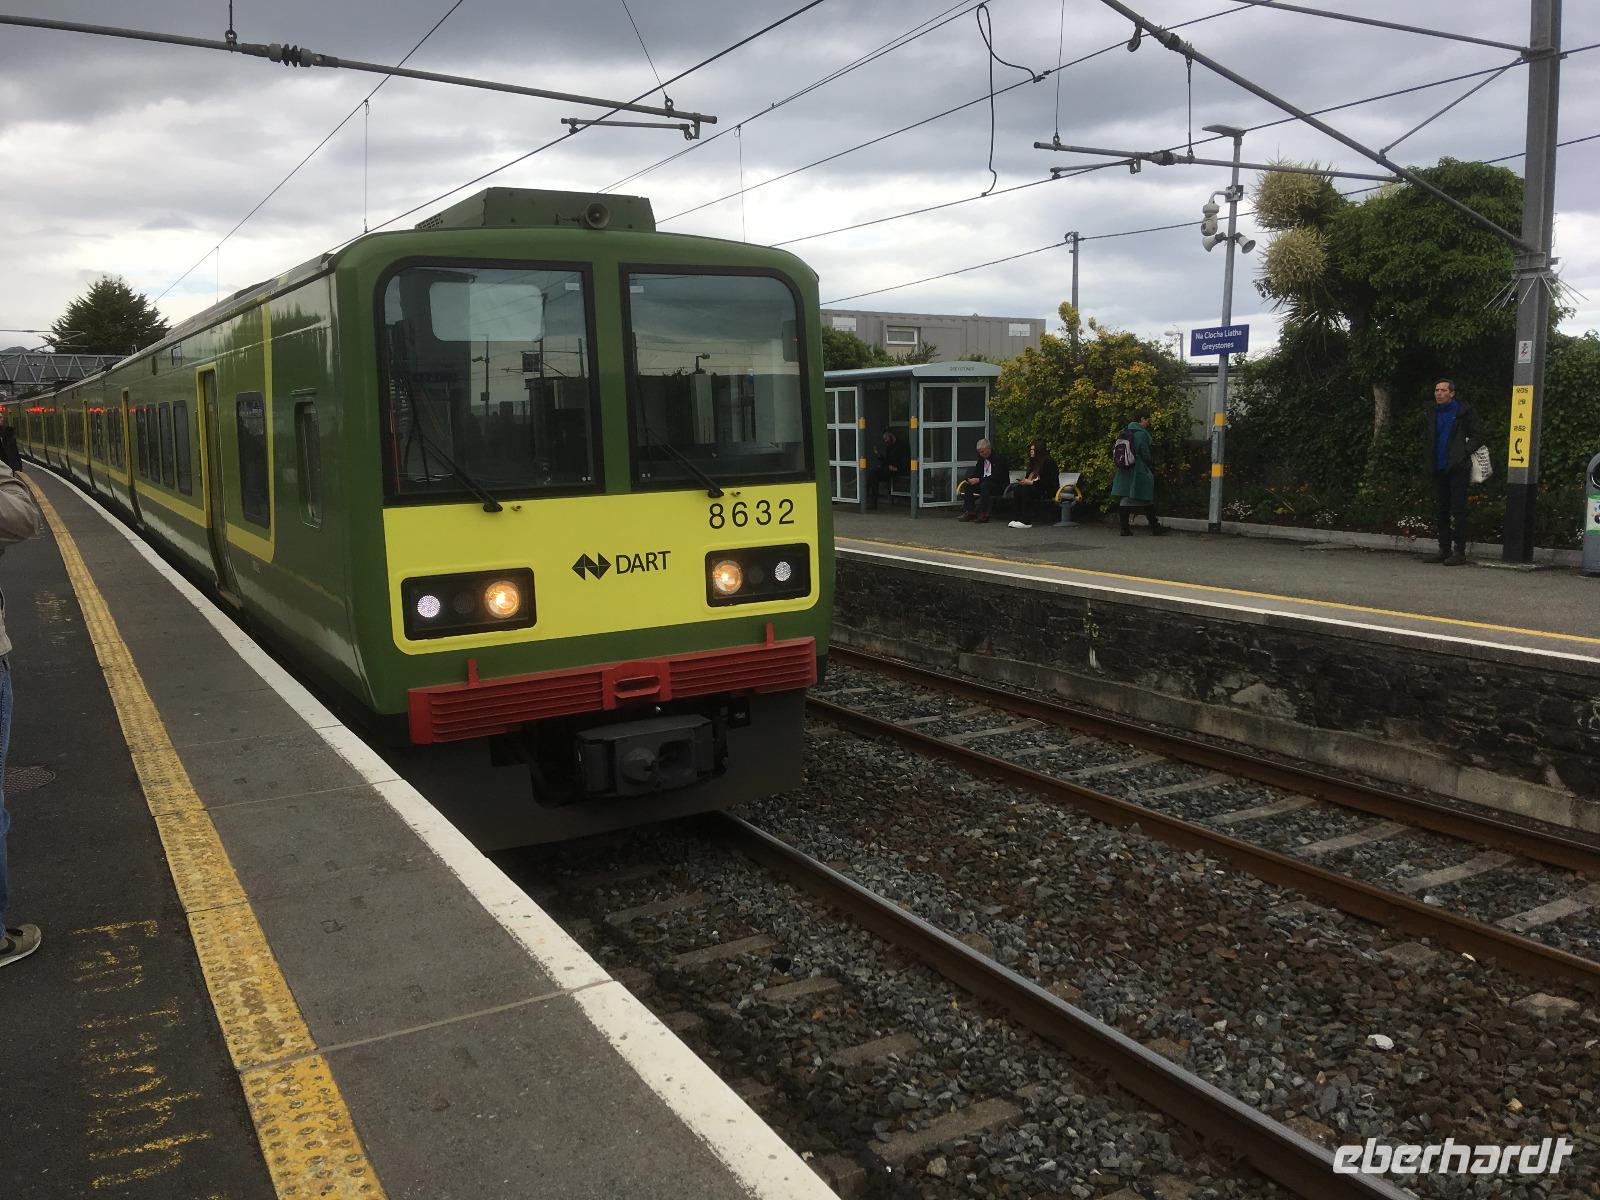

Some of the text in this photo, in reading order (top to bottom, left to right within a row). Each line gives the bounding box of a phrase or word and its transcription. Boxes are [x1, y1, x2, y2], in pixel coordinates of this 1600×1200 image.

[1195, 329, 1242, 340] Na Clocha Liatha
[1201, 342, 1234, 351] Greystones
[708, 498, 795, 530] 8632
[615, 550, 671, 575] DART
